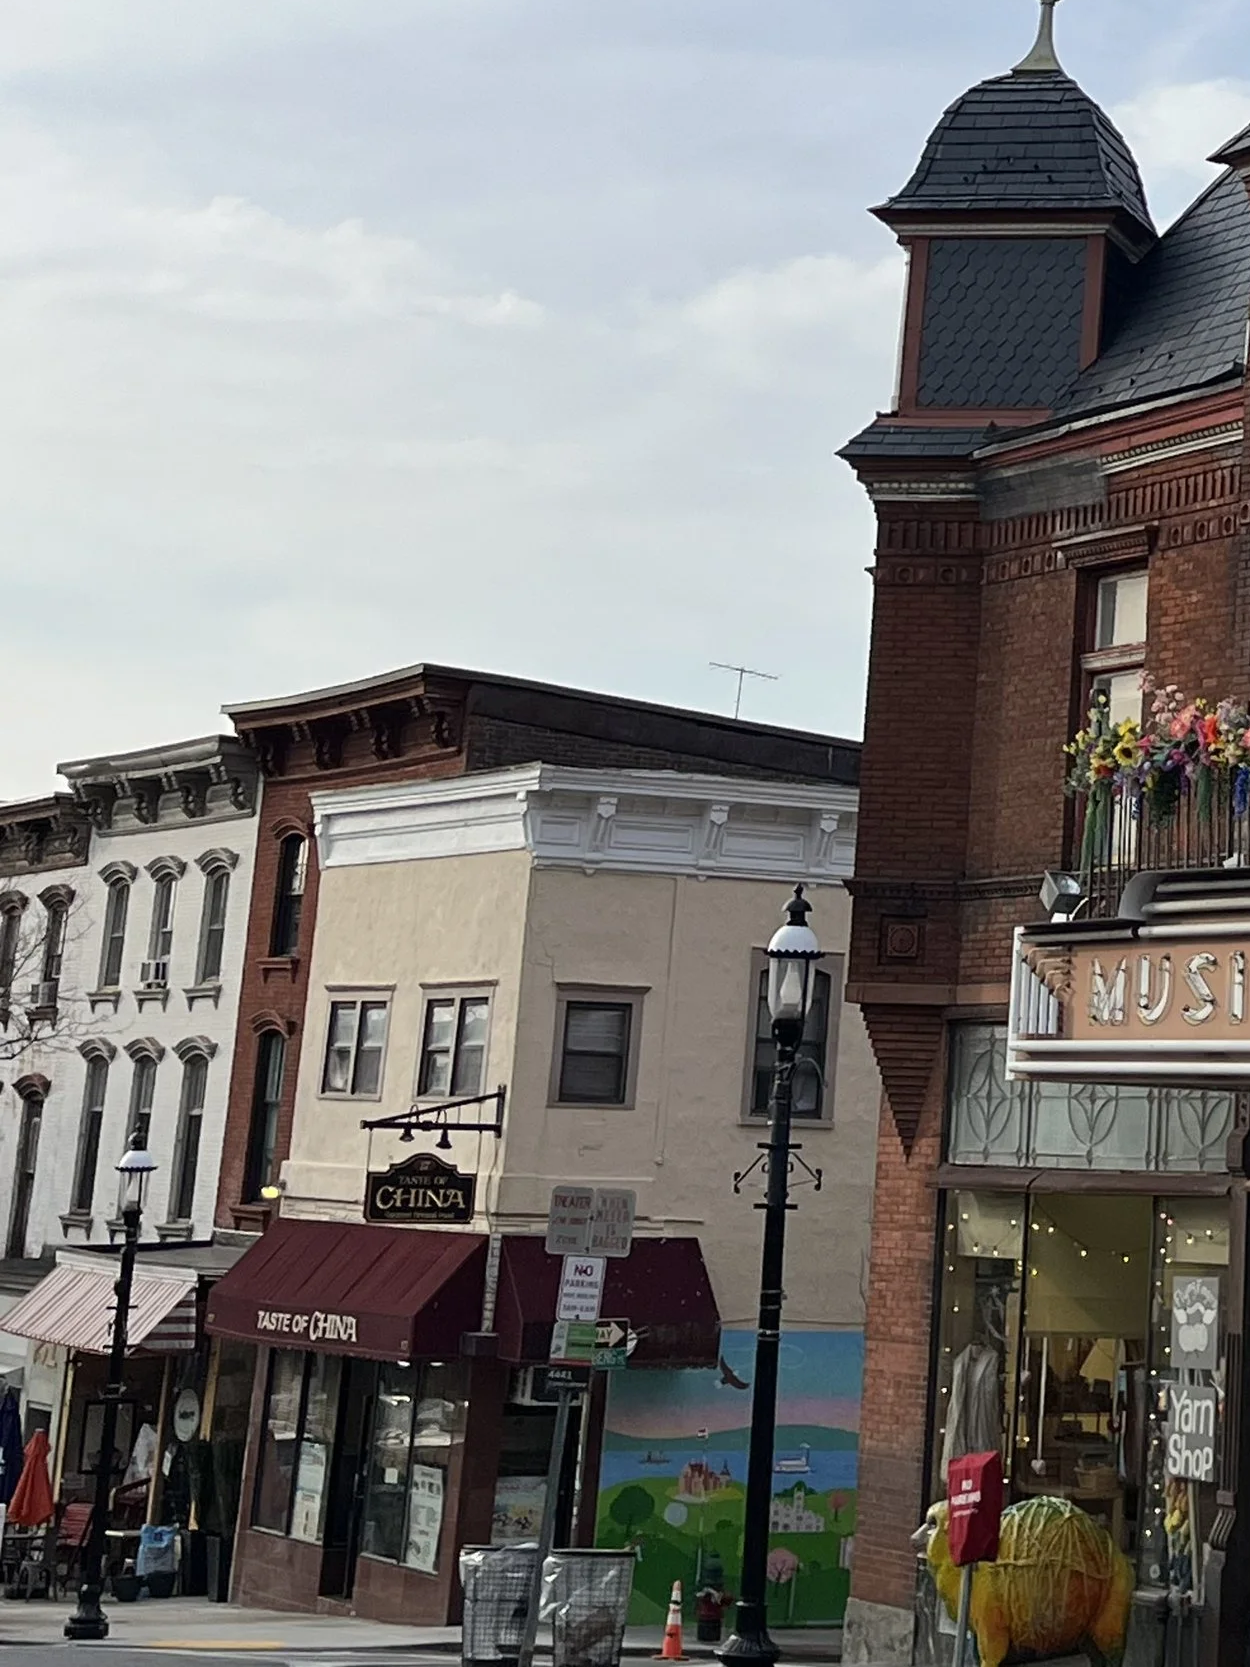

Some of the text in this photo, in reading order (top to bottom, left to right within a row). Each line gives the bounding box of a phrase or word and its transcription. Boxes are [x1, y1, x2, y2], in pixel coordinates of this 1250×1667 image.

[376, 1185, 466, 1210] CHINA
[573, 1264, 595, 1277] NO
[257, 1310, 357, 1343] TASTE OF CHINA
[1170, 1389, 1214, 1437] Yarn
[1168, 1433, 1214, 1481] Shop
